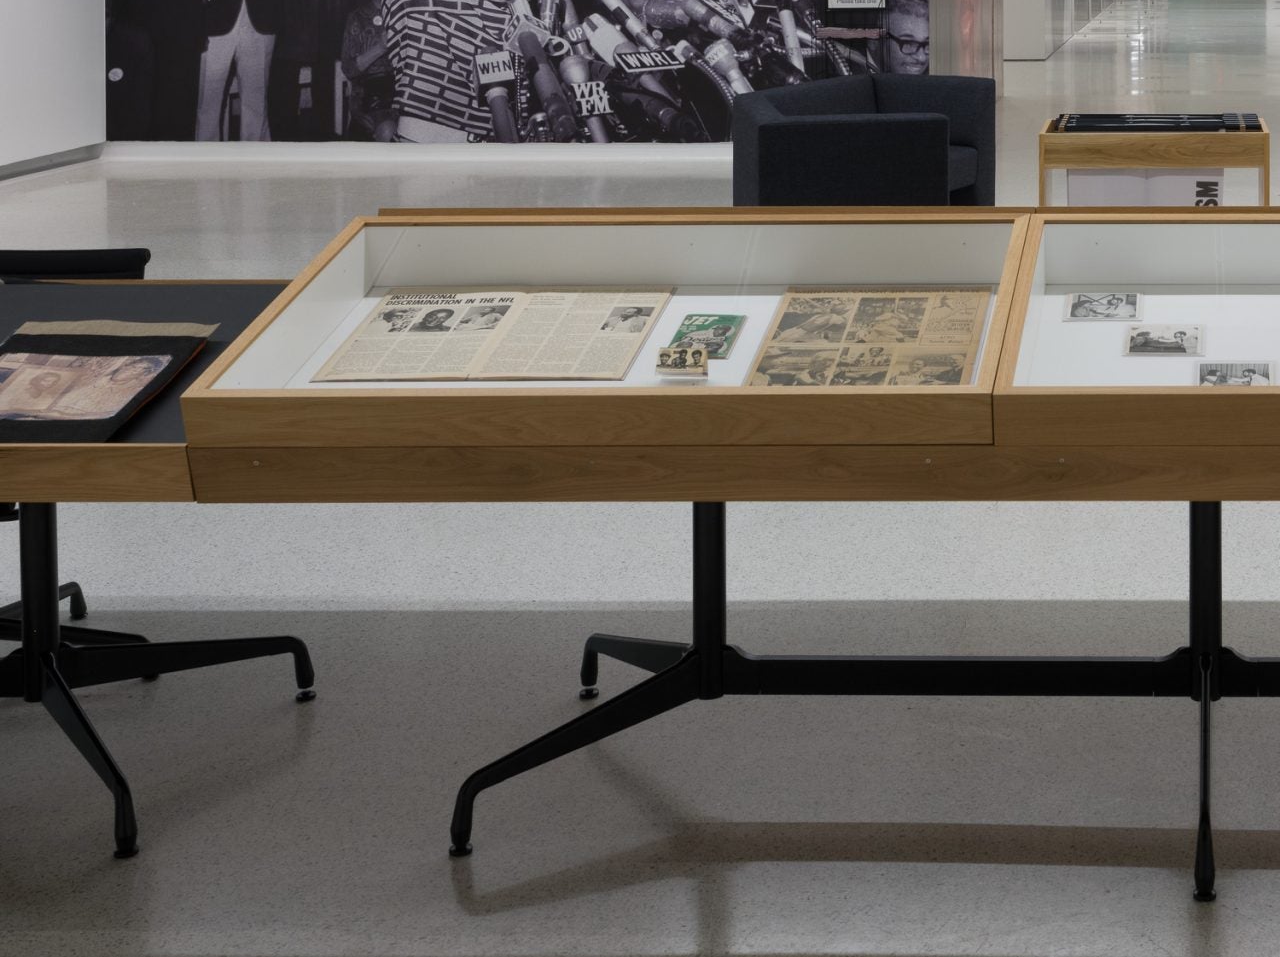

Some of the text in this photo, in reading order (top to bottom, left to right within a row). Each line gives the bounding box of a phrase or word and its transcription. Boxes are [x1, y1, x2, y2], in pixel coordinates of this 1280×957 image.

[478, 58, 512, 75] WHN
[621, 52, 680, 69] WWRL
[577, 95, 614, 117] FM
[684, 316, 719, 324] JET
